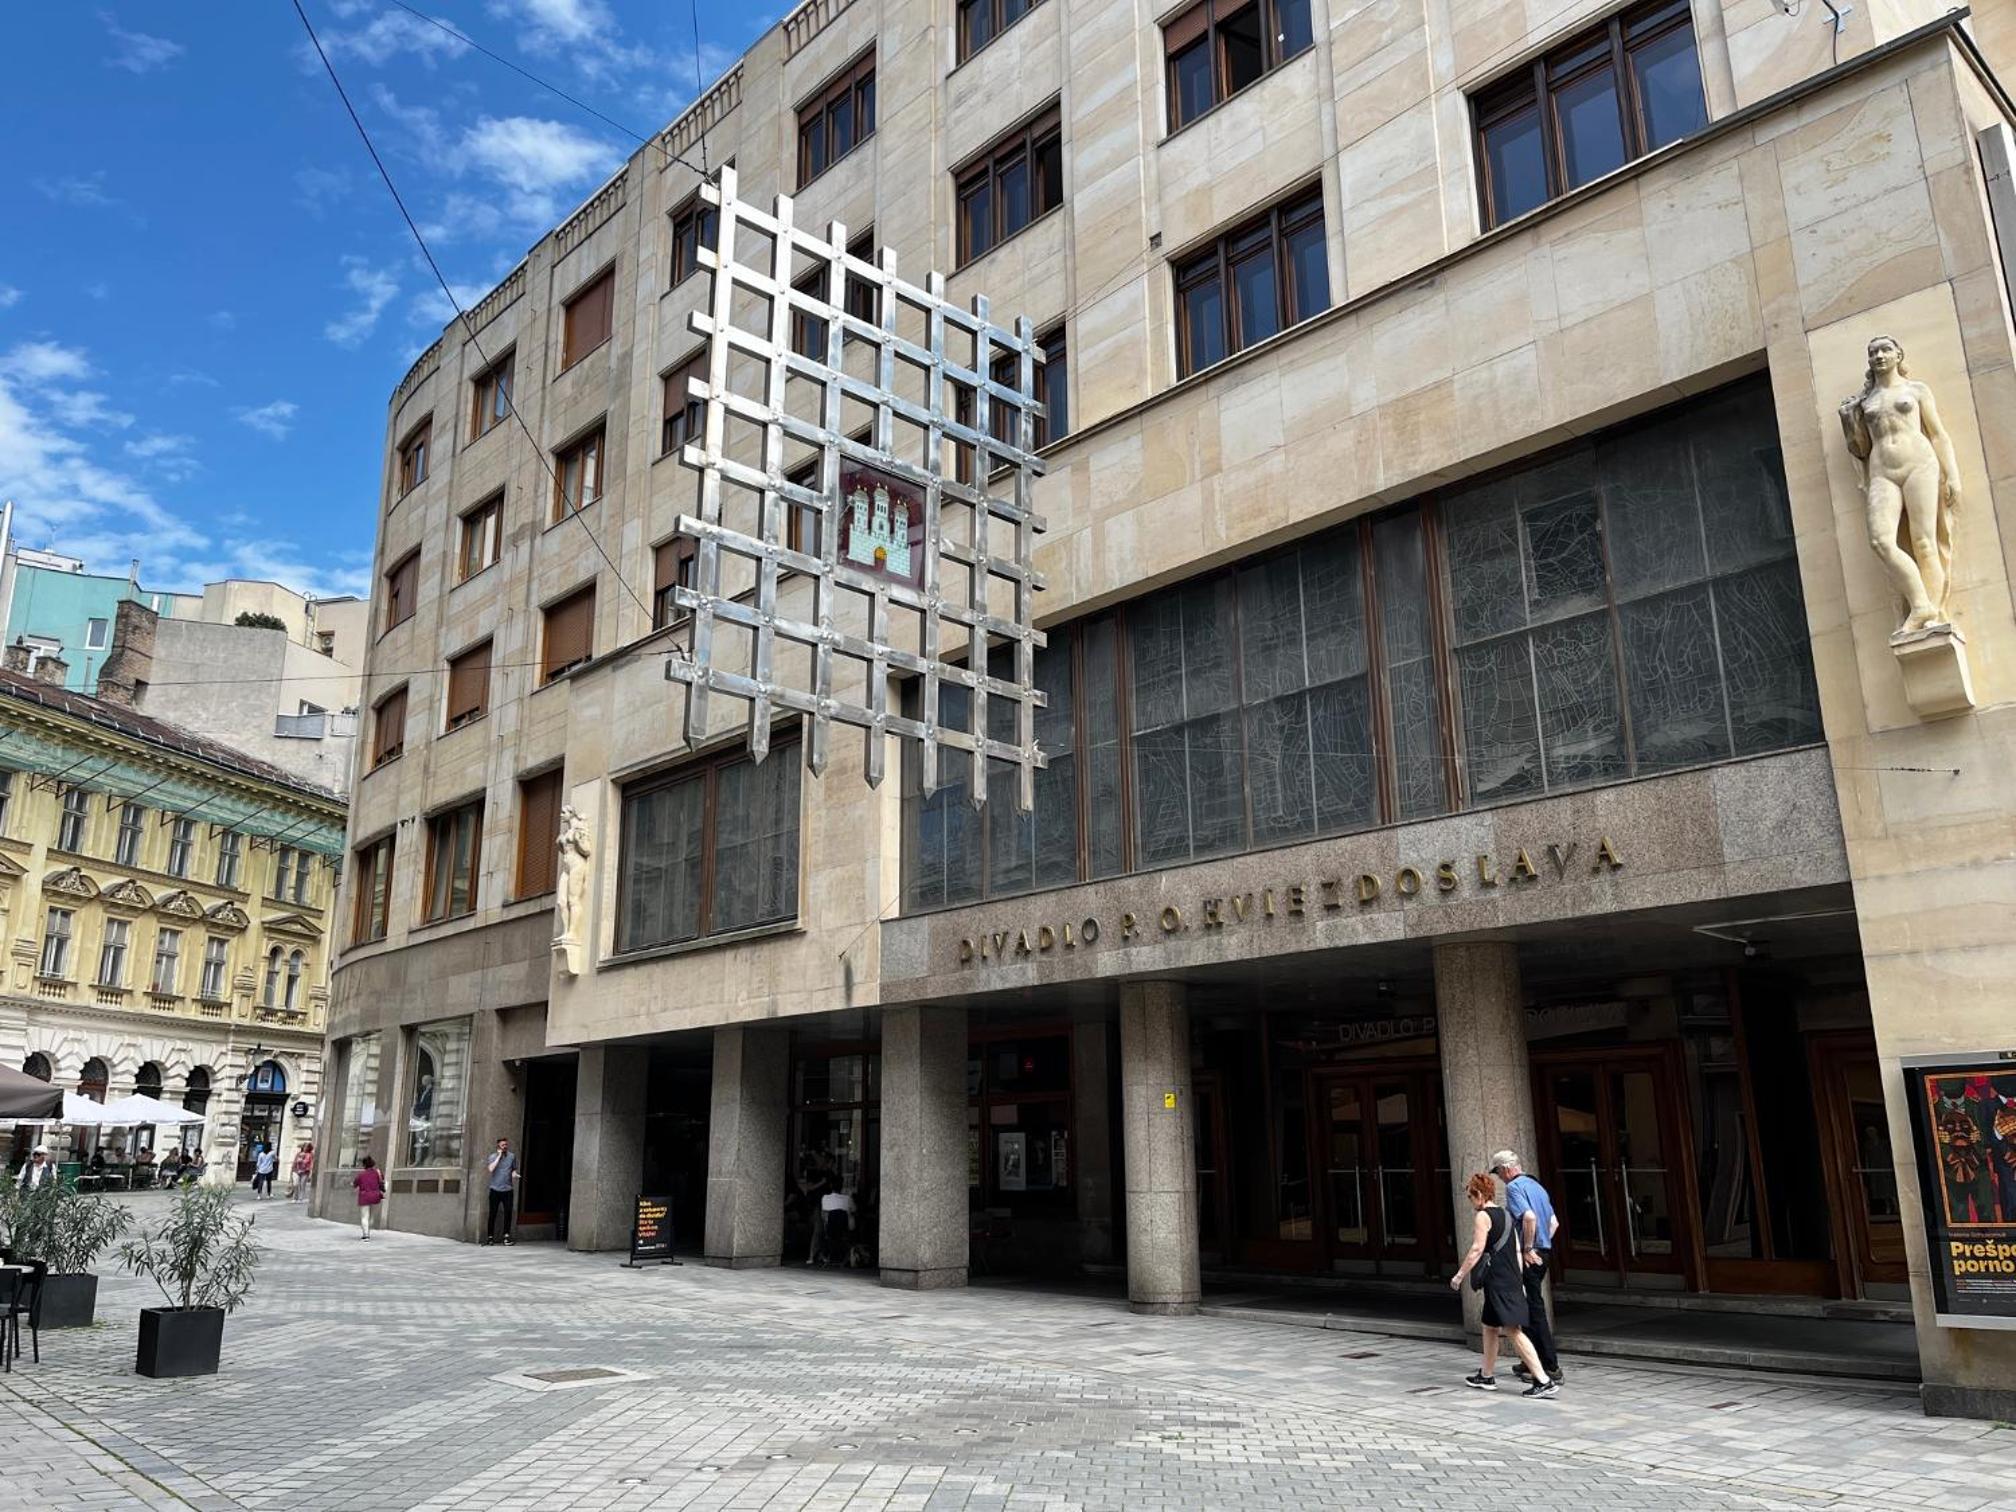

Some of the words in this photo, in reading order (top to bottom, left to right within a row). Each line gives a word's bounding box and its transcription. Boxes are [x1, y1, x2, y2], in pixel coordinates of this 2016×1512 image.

[960, 916, 1102, 962] DIVADLO
[1121, 911, 1140, 940] P.
[1160, 904, 1190, 932] O.
[1203, 835, 1624, 928] HVIEZDOSLAVA
[1953, 1259, 2016, 1276] porno
